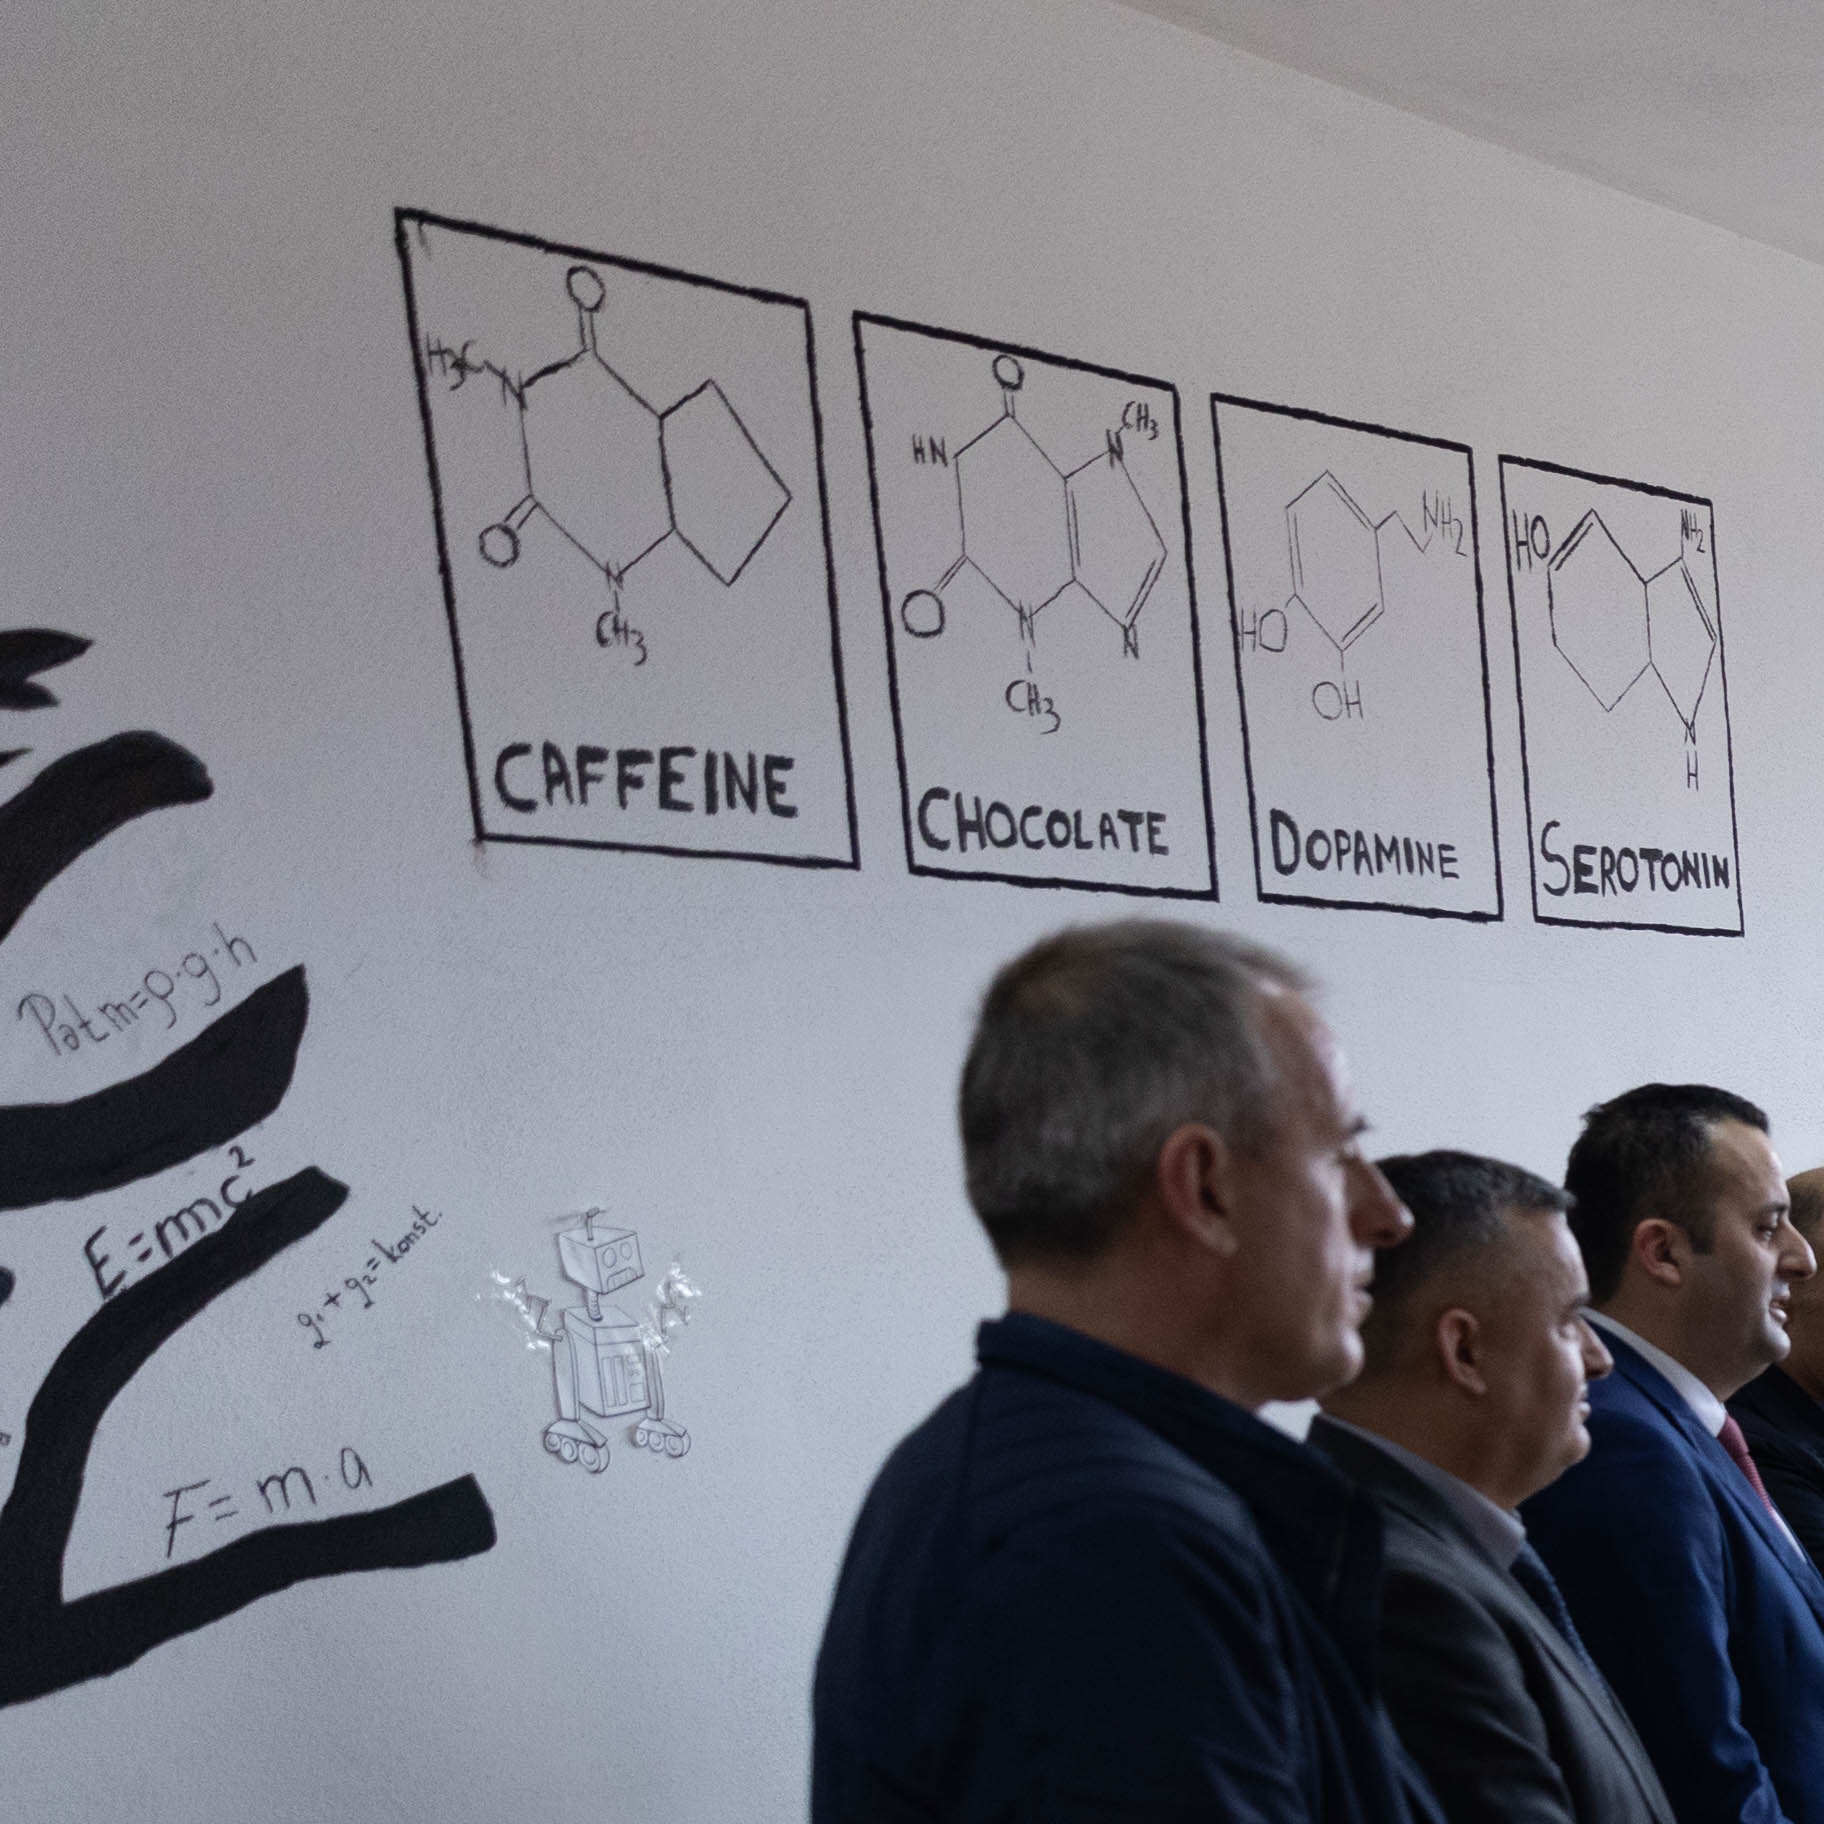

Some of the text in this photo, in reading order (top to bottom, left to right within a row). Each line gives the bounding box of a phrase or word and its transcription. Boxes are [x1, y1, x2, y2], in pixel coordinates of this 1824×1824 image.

[1311, 680, 1364, 720] OH
[494, 741, 798, 818] CAFFEINE
[918, 786, 1169, 856] CHOCOLATE
[1269, 808, 1460, 880] DOPAMINE
[1540, 820, 1731, 898] SEROTONIN
